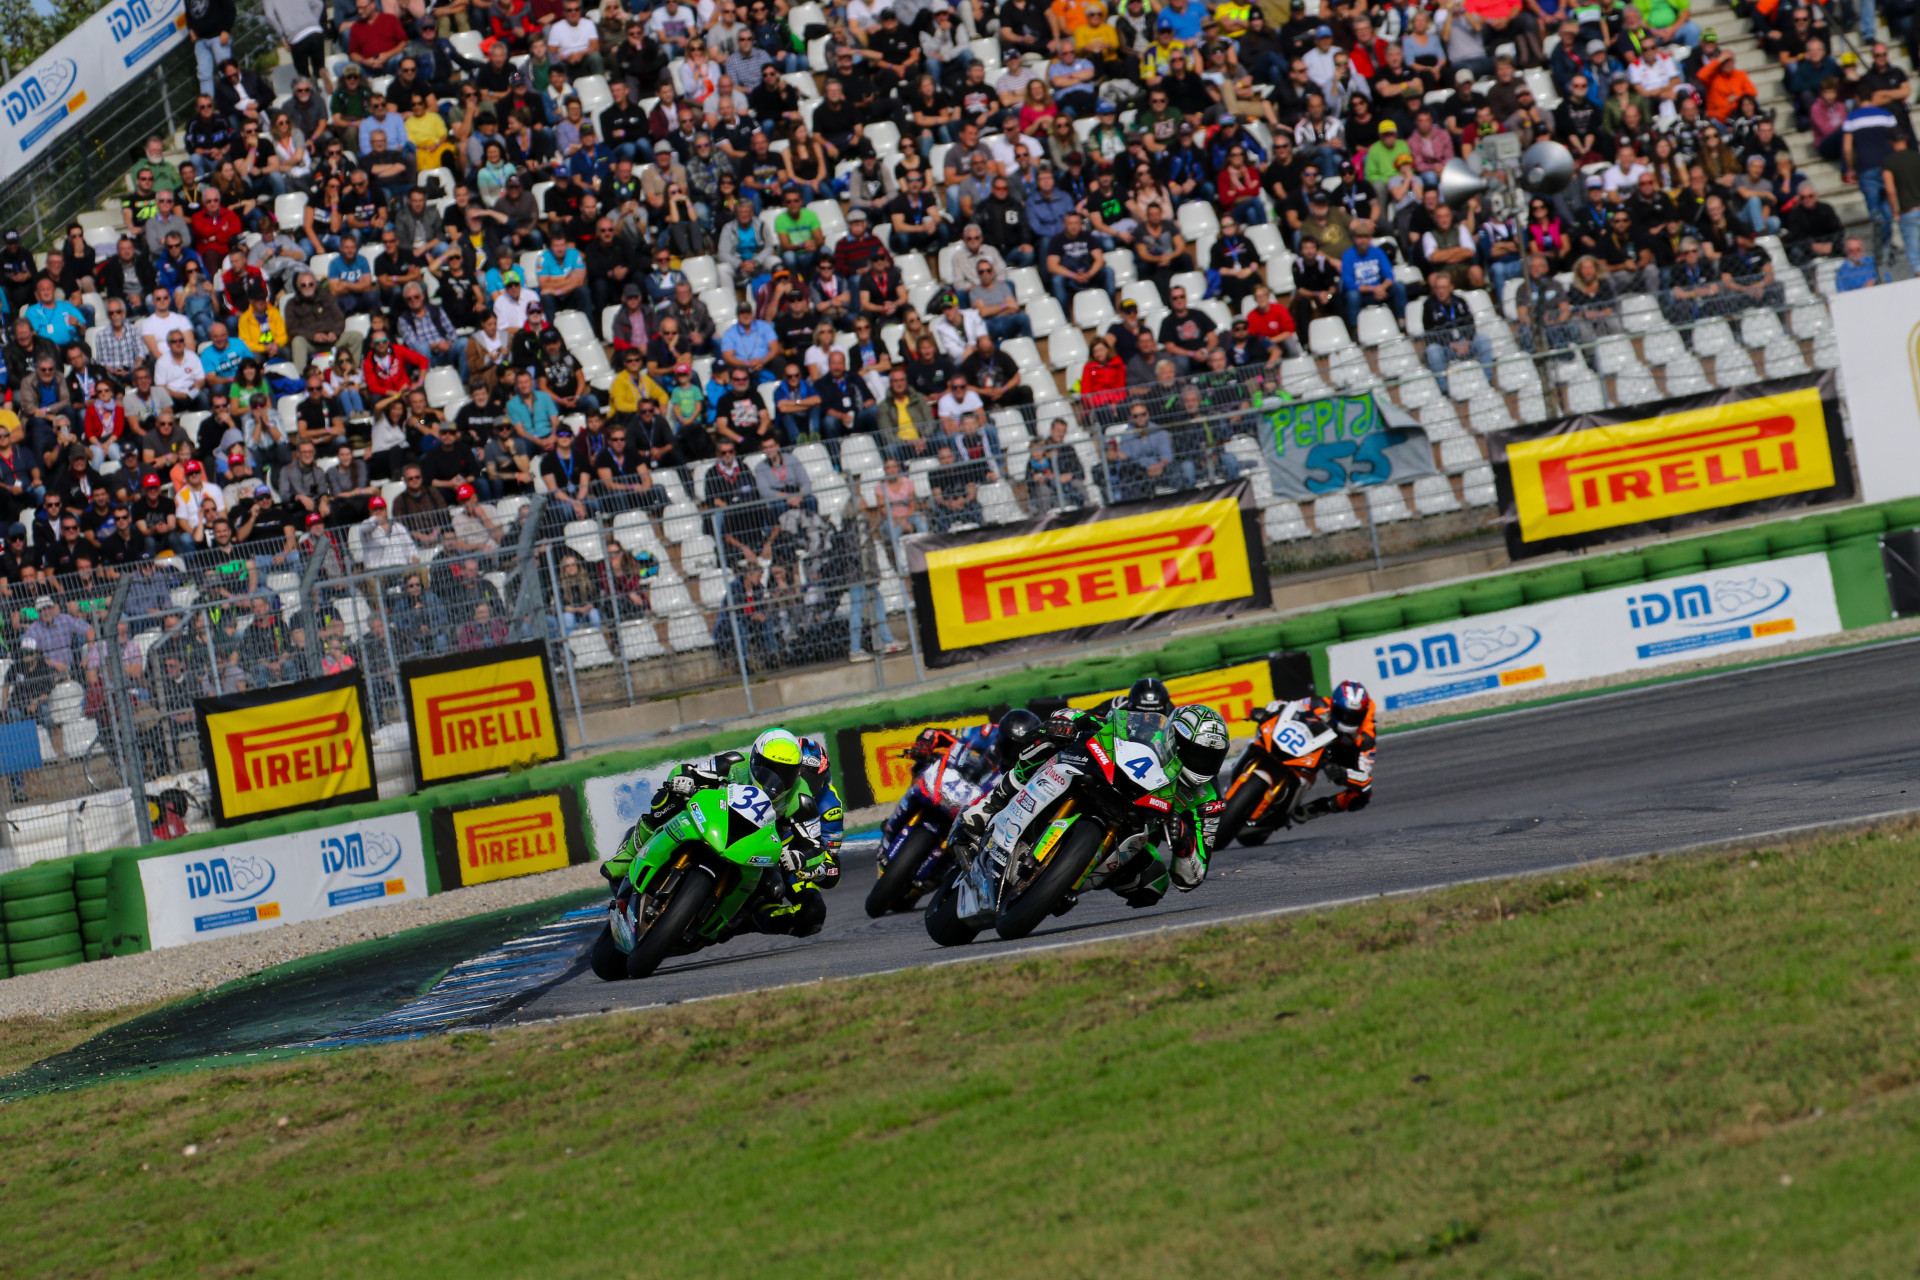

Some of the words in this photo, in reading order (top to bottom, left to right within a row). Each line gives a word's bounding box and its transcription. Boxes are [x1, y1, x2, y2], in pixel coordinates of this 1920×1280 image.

[1305, 432, 1408, 494] 55
[1539, 415, 1798, 516] PIRELLI
[957, 524, 1217, 624] PIRELLI
[426, 680, 541, 756] PIRELLI
[1276, 727, 1306, 755] 62
[225, 711, 353, 793] PIRELLI
[1089, 743, 1111, 766] MOTUL
[1124, 756, 1154, 780] 4
[731, 786, 772, 823] 34
[1148, 797, 1169, 810] MOTUL
[465, 812, 556, 868] PIRELLI
